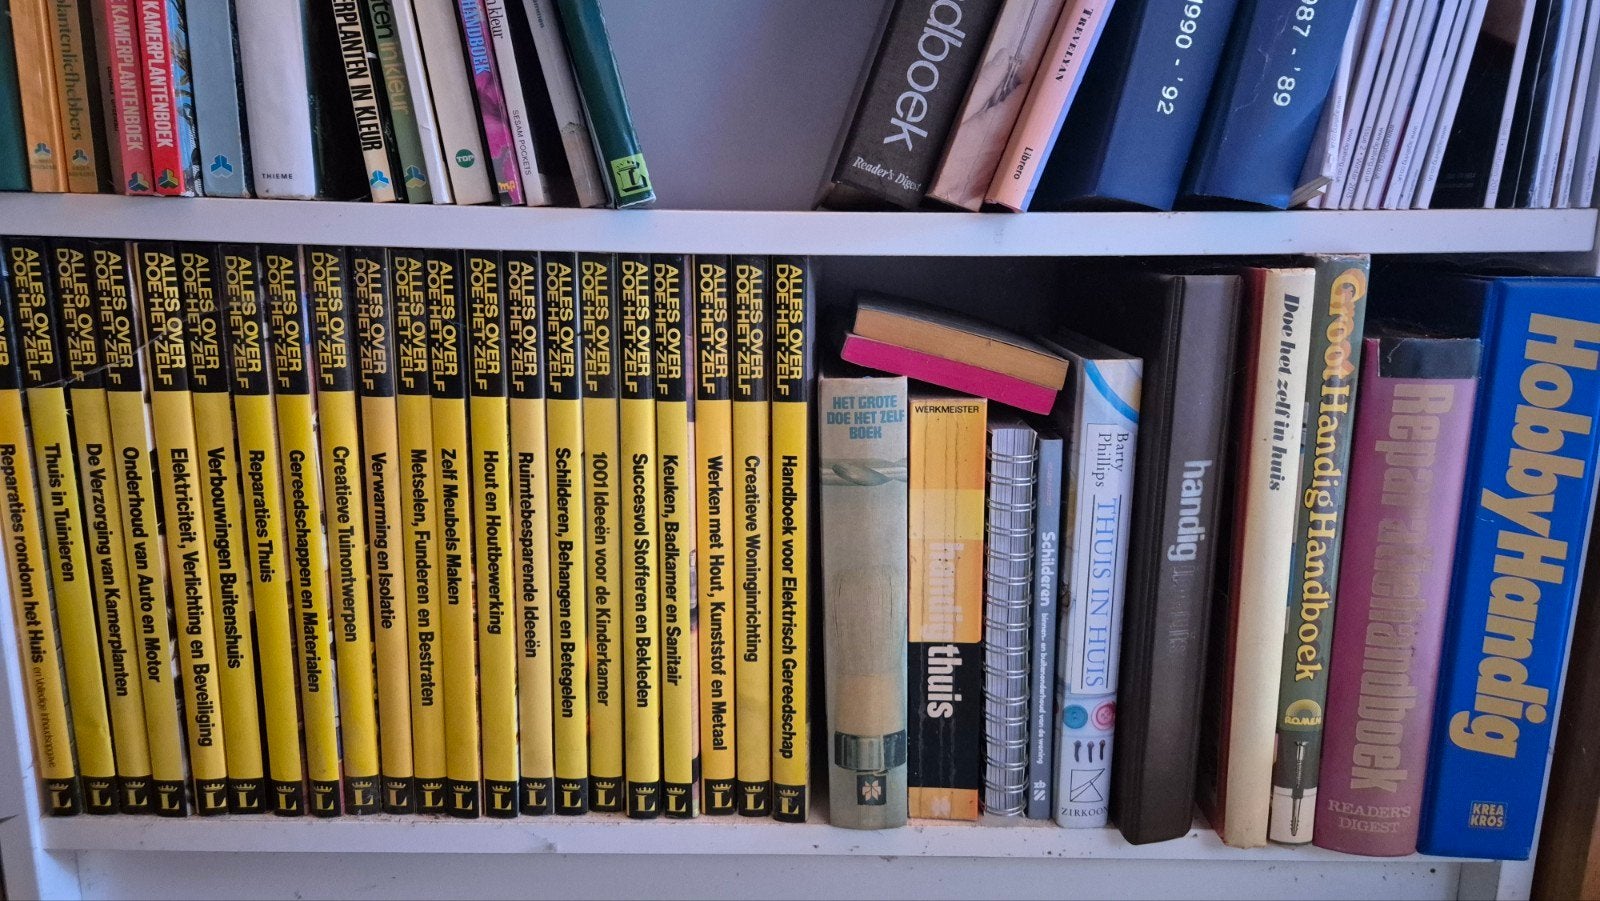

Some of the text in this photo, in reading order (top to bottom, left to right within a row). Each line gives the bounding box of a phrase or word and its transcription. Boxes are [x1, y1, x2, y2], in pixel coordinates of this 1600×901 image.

[111, 4, 144, 151] KAMERPLANTENBOEK
[142, 0, 174, 148] KAMERPLANTENBOEK
[333, 0, 383, 152] RPLANTEN IN KLEUR
[380, 42, 398, 60] in
[487, 7, 504, 39] kleur
[882, 0, 967, 152] dboek
[1055, 7, 1094, 82] TREVELYAN
[382, 63, 408, 115] kleur
[512, 109, 532, 176] SESAM POCKETS
[852, 155, 922, 192] Reader's Digest
[1013, 146, 1034, 181] Librero
[24, 247, 54, 364] ALLES OVER
[788, 264, 804, 380] ALLES OVER
[826, 410, 906, 425] DOE HET ZELF
[832, 395, 898, 410] HET GROTE
[849, 426, 882, 440] BOEK
[914, 405, 980, 414] WERKMEISTER
[1268, 293, 1301, 492] Doe het zelf in huis
[0, 443, 26, 533] Reparaties
[44, 442, 74, 582] Thuis in Tuinieren
[247, 449, 275, 582] Reparaties Thuis
[1091, 432, 1112, 488] Phillips
[1167, 459, 1213, 562] handig
[14, 535, 34, 598] rondom
[85, 443, 129, 696] De Verzorging van Kamerplanten
[122, 446, 162, 683] Onderhoud van Auto en Motor
[206, 446, 244, 668] Verbouwingen Buitenshuis
[288, 449, 322, 692] Gereedschappen en Materialen
[332, 446, 357, 642] Creatieve Tuinontwerpen
[370, 451, 396, 629] Verwarming en Isolatie
[410, 448, 436, 706] Metselen, Funderen en Bestraten
[440, 447, 462, 605] Zelf Meubels Maken
[483, 450, 504, 634] Hout en Houtbewerking
[518, 451, 540, 658] Ruimtebesparende Ideeën
[554, 447, 576, 718] Schilderen, Behangen en Betegelen
[592, 451, 612, 706] 1001 Ideeën voor de Kinderkamer
[632, 453, 652, 708] Succesvol Stofferen en Bekleden
[660, 454, 682, 686] Keuken, Badkamer en Sanitair
[742, 455, 761, 662] Creatieve Woninginrichting
[1039, 531, 1055, 607] Schilderen
[1349, 383, 1456, 793] Reparatiehandboek
[23, 600, 41, 626] het
[27, 629, 47, 663] Huis
[170, 447, 215, 747] Elektriciteit, Verlichting en Beveiliging
[706, 455, 728, 750] Werken met Hout, Kunststof en Metaal
[778, 454, 798, 759] Handboek voor Elektrisch Gereedschap
[1085, 497, 1118, 688] THUIS IN HUIS
[926, 644, 963, 719] thuis
[1284, 714, 1322, 726] ROMEN
[205, 790, 227, 808] L
[1327, 798, 1411, 817] READER'S
[1337, 816, 1400, 834] DIGEST
[1470, 815, 1504, 828] KROS
[1471, 803, 1504, 816] KREA
